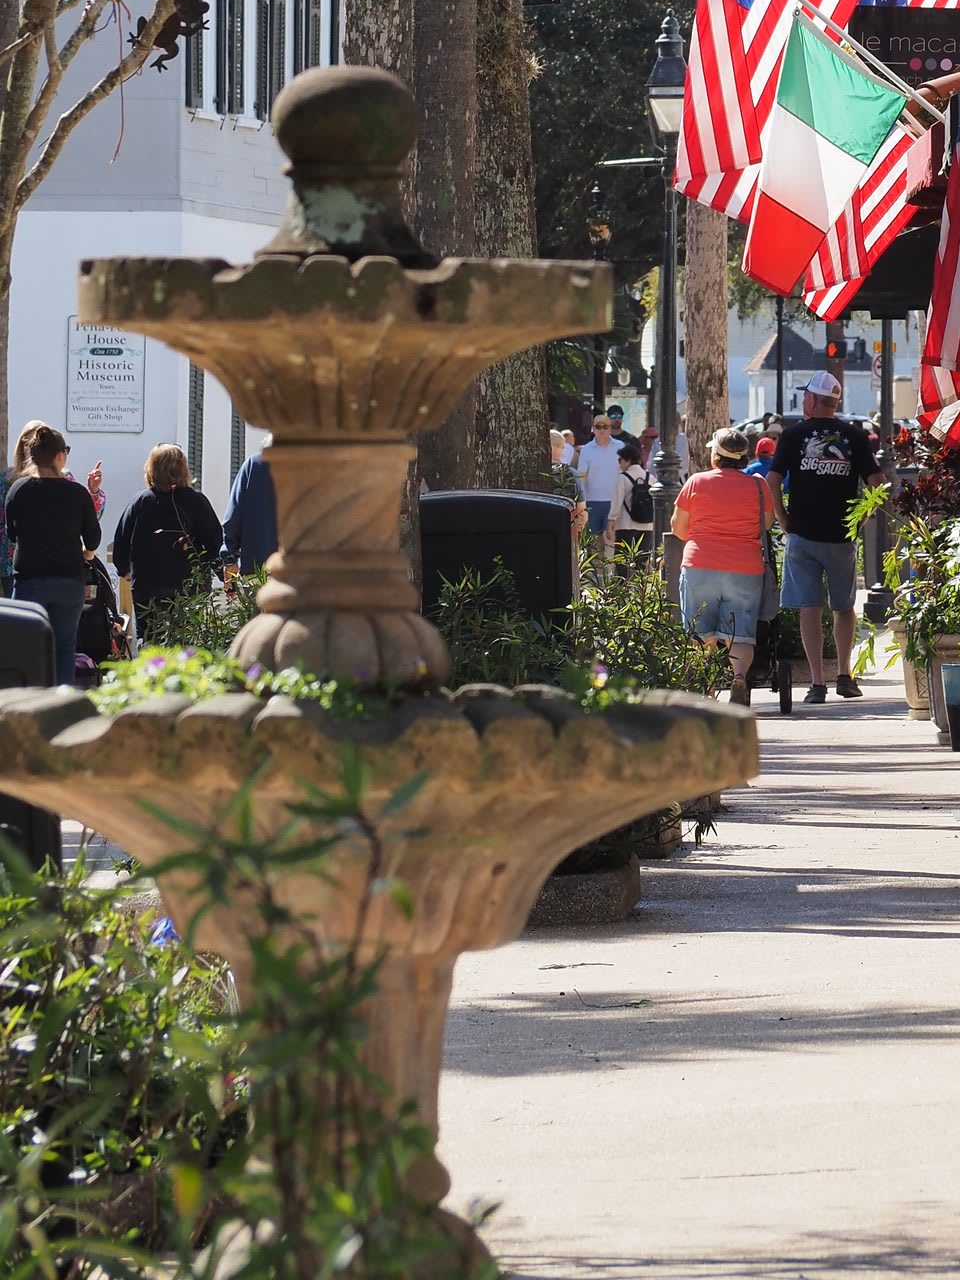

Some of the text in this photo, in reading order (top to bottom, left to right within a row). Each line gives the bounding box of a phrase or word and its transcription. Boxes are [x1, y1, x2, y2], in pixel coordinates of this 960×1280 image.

[861, 31, 881, 51] le
[87, 334, 127, 345] House
[78, 359, 134, 370] Historic
[76, 371, 135, 382] Museum
[106, 405, 139, 414] Exchange
[104, 413, 123, 422] Shop
[800, 458, 851, 476] SIG SAUER
